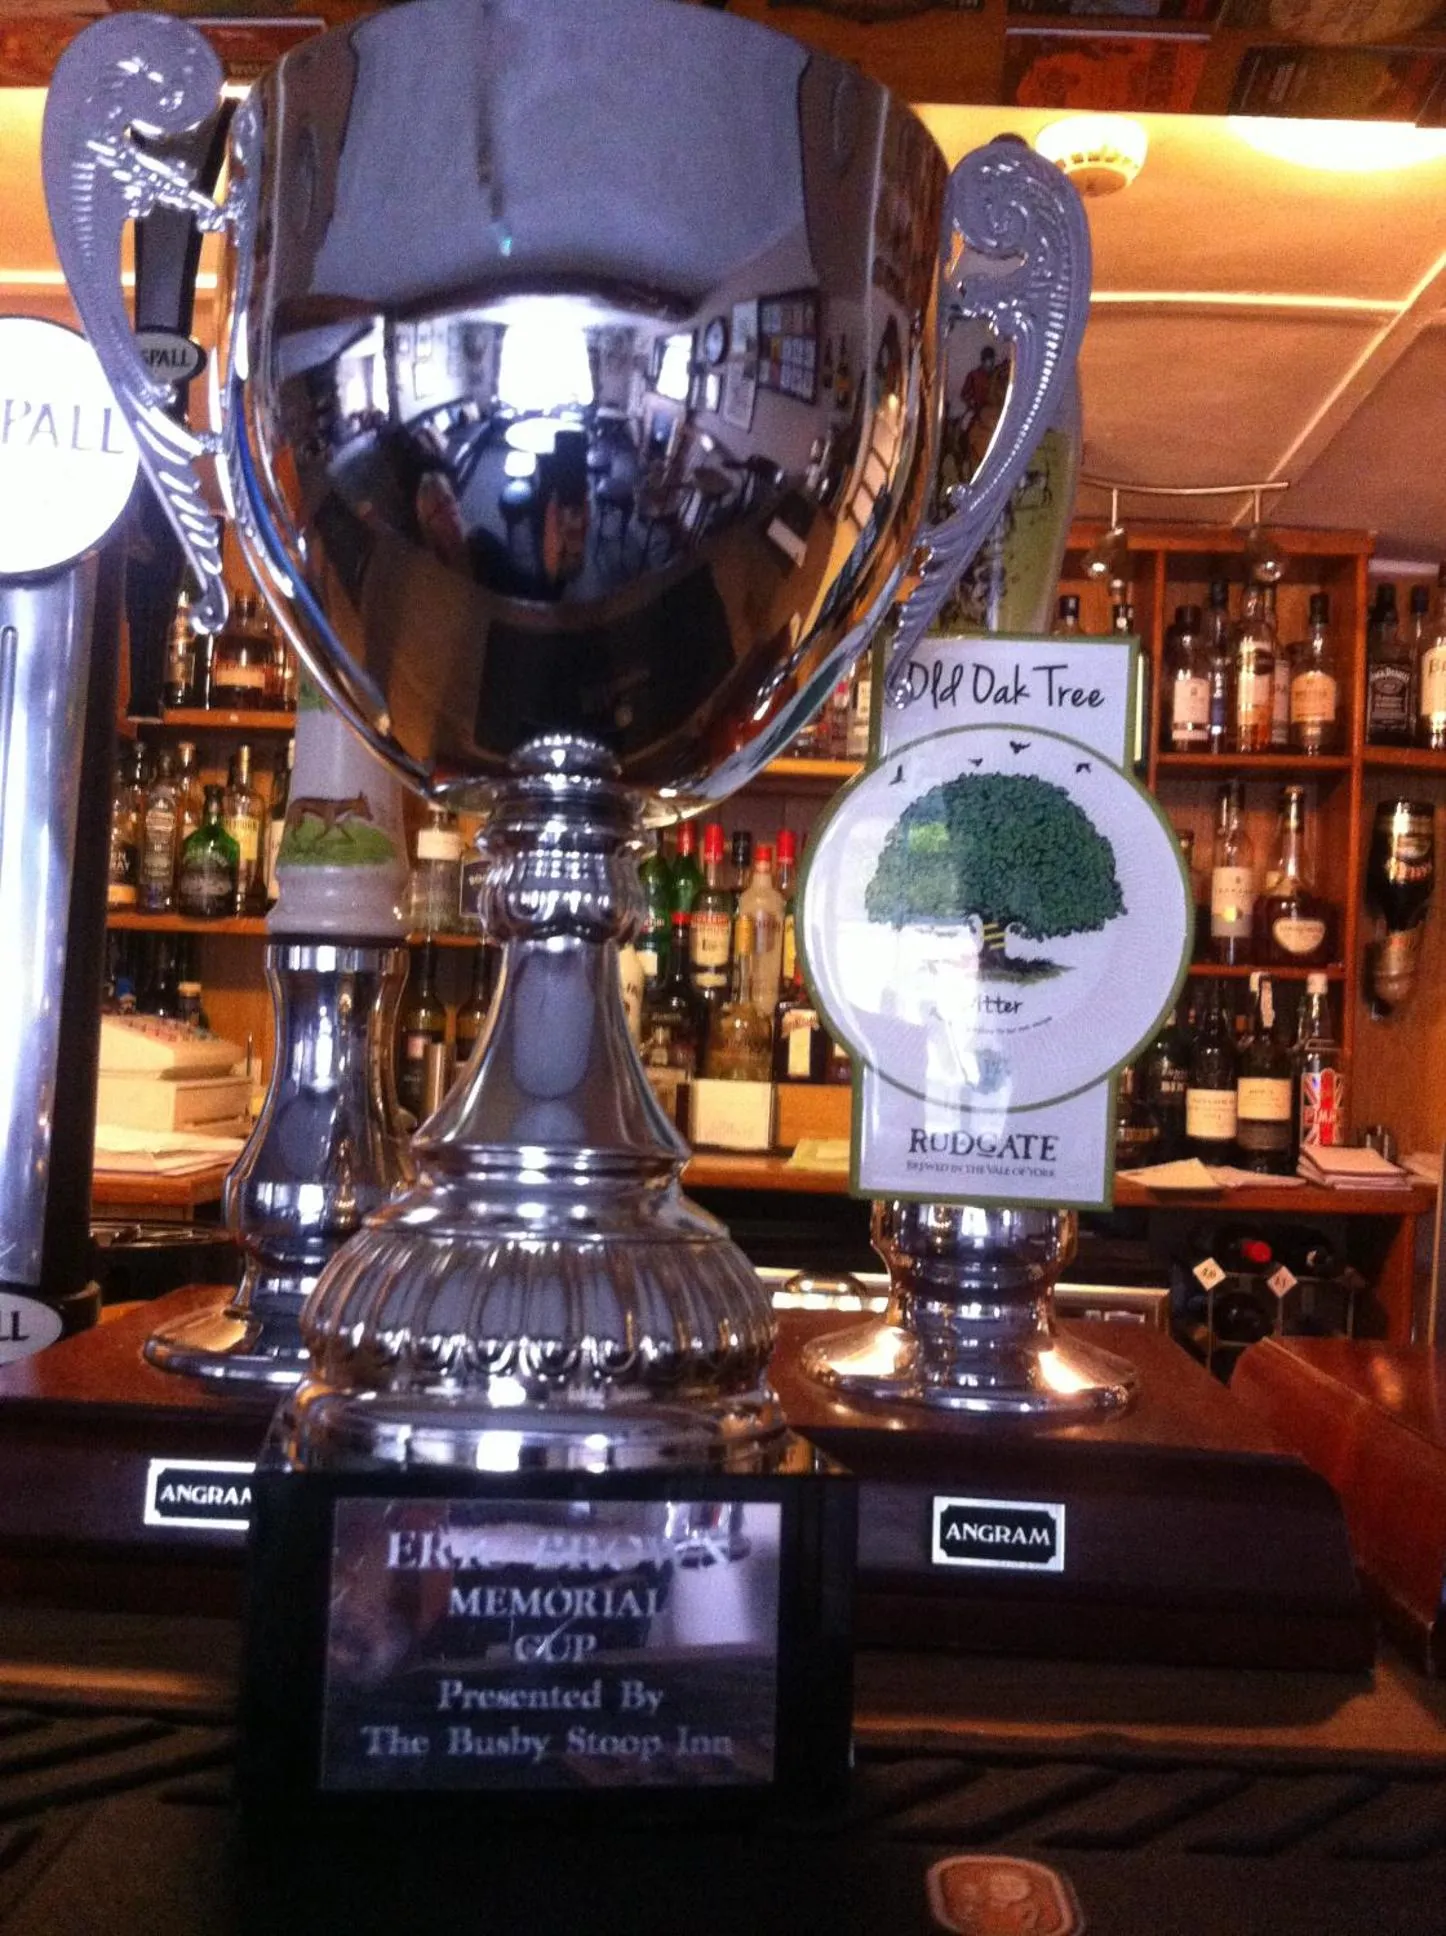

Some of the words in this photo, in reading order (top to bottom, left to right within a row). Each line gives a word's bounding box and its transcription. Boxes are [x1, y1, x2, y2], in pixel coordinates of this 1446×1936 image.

[907, 659, 963, 709] Old
[972, 663, 1031, 705] Oak
[1033, 664, 1105, 708] Tree
[908, 1128, 1060, 1162] RUDGATE
[945, 1522, 1051, 1546] ANGRAM
[436, 1679, 602, 1710] Presented
[619, 1679, 665, 1716] By
[361, 1725, 430, 1757] The
[447, 1726, 550, 1763] Busby
[567, 1726, 663, 1762] Stoop
[677, 1727, 735, 1757] Inn
